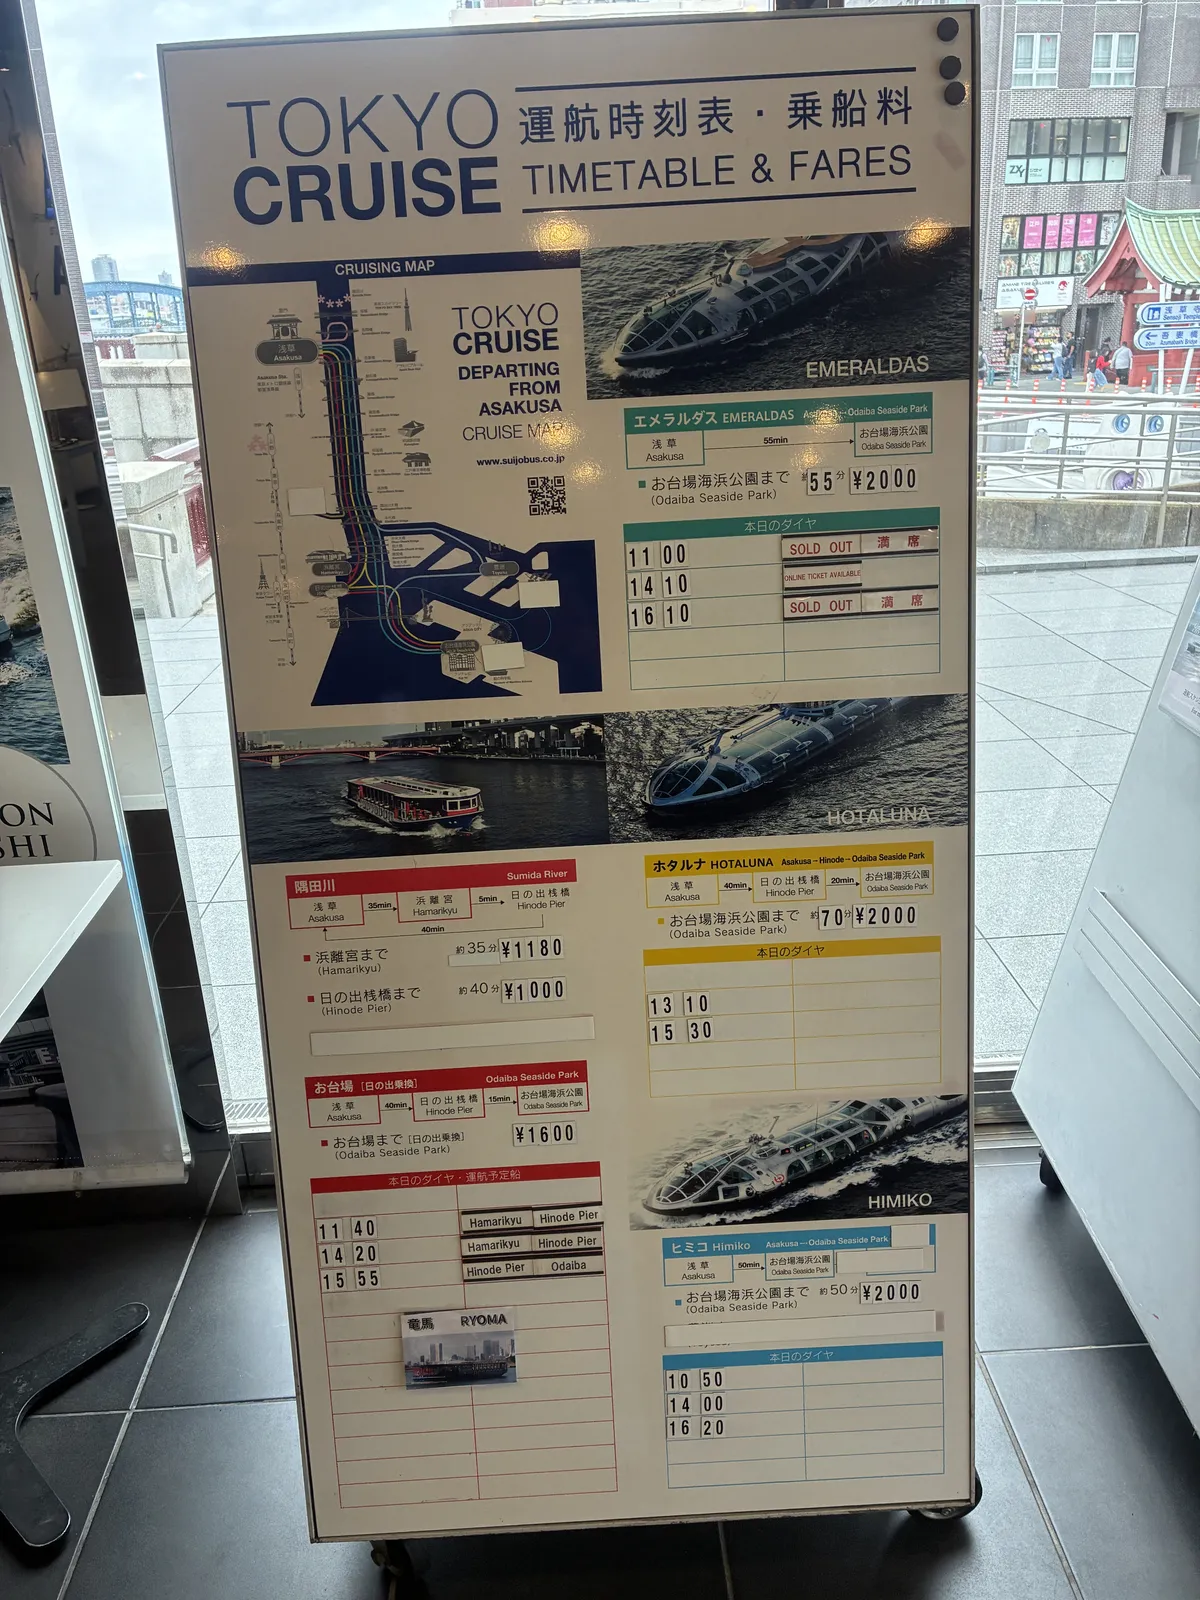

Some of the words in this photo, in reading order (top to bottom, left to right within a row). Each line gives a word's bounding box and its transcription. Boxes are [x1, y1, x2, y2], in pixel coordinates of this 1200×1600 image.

[226, 88, 500, 160] TOKYO
[521, 155, 732, 195] TIMETABLE
[751, 154, 775, 182] &
[790, 146, 912, 181] FARES
[233, 157, 501, 226] CRUISE
[335, 262, 401, 275] CRUISING
[405, 260, 435, 272] MAP
[452, 303, 558, 329] TOKYO
[453, 328, 559, 355] CRUISE
[458, 362, 559, 380] DEPARTING
[807, 355, 929, 379] EMERALDAS
[509, 380, 560, 396] FROM
[479, 399, 562, 416] ASAKUSA
[634, 411, 717, 428] エメラルダス
[723, 410, 794, 424] EMERALDAS
[848, 407, 875, 416] Odaiba
[878, 405, 907, 414] Seaside
[910, 403, 928, 413] Park
[463, 425, 522, 441] CRUISE
[859, 424, 928, 439] お台場海浜公園
[652, 438, 677, 449] 浅草
[764, 436, 788, 445] 55min
[861, 441, 883, 450] Odaiba
[885, 440, 909, 449] Seaside
[910, 440, 927, 448] Park
[477, 455, 565, 466] www.suijobus.co.jp
[646, 452, 684, 462] Asakusa
[652, 470, 791, 491] お台場海浜公園まで
[853, 468, 917, 490] ¥2000
[651, 492, 695, 506] (Odaiba
[699, 491, 743, 503] Seaside
[748, 489, 777, 500] Park)
[744, 518, 817, 533] 本日のダイヤ
[630, 547, 650, 567] 11
[663, 544, 685, 564] 00
[790, 543, 821, 555] SOLD
[830, 541, 853, 553] OUT
[784, 573, 806, 581] ONLINE
[808, 572, 828, 580] TICKET
[829, 570, 861, 578] AVAILABLE
[631, 576, 652, 596] 14
[665, 573, 687, 595] 10
[631, 606, 654, 626] 16
[667, 603, 689, 624] 10
[828, 806, 931, 826] HOTALUNA
[653, 858, 706, 872] ホタルナ
[710, 858, 774, 870] HOTALUNA
[781, 857, 812, 866] Asakusa
[819, 856, 844, 864] Hinode
[852, 854, 877, 862] Odaiba
[879, 852, 907, 861] Seaside
[908, 852, 925, 860] Park
[294, 878, 335, 893] 隅田川
[507, 870, 542, 880] Sumida
[544, 870, 568, 878] River
[670, 881, 694, 891] 浅草
[724, 882, 747, 890] 40min
[831, 876, 854, 884] 20min
[368, 902, 392, 910] 35min
[517, 900, 548, 910] Hinode
[550, 900, 566, 908] Pier
[664, 893, 700, 902] Asakusa
[314, 902, 337, 912] 浅草
[412, 906, 458, 916] Hamarikyu
[856, 906, 916, 924] ¥2000
[308, 913, 344, 923] Asakusa
[670, 910, 800, 927] お台場海浜公園まで
[316, 947, 388, 964] 浜離宮まで
[502, 938, 562, 958] ¥1180
[756, 945, 824, 958] 本日のダイヤ
[318, 963, 382, 976] (Hamarikyu)
[320, 986, 421, 1004] 日の出桟橋まで
[504, 980, 563, 1000] ¥1000
[321, 1005, 364, 1016] (Hinode
[367, 1003, 392, 1014] Pier)
[650, 997, 672, 1014] 13
[686, 995, 708, 1012] 10
[652, 1024, 673, 1042] 15
[690, 1022, 712, 1038] 30
[314, 1081, 354, 1094] お台場
[486, 1074, 518, 1084] Odaiba
[520, 1072, 556, 1082] Seaside
[558, 1070, 579, 1080] Park
[520, 1088, 584, 1100] お台場海浜公園
[334, 1134, 402, 1149] お台場まで
[516, 1124, 574, 1143] ¥1600
[335, 1150, 376, 1160] (Odaiba
[380, 1148, 420, 1158] Seaside
[424, 1145, 450, 1156] Park)
[868, 1193, 932, 1209] HIMIKO
[470, 1215, 522, 1228] Hamarikyu
[540, 1212, 576, 1224] Hinode
[579, 1210, 598, 1221] Pier
[320, 1223, 339, 1240] 11
[354, 1220, 375, 1236] 40
[468, 1238, 520, 1252] Hamarikyu
[538, 1238, 574, 1248] Hinode
[577, 1236, 597, 1246] Pier
[672, 1242, 708, 1253] ヒミコ
[713, 1241, 750, 1252] Himiko
[766, 1240, 799, 1248] Asakusa
[808, 1238, 836, 1246] Odaiba
[838, 1236, 869, 1245] Seaside
[871, 1234, 889, 1243] Park
[322, 1248, 343, 1264] 14
[356, 1245, 376, 1262] 20
[467, 1264, 502, 1277] Hinode
[505, 1262, 525, 1274] Pier
[551, 1260, 586, 1272] Odaiba
[738, 1261, 760, 1269] 50min
[324, 1272, 344, 1290] 15
[358, 1270, 378, 1287] 55
[687, 1286, 809, 1304] お台場海浜公園まで
[863, 1284, 920, 1301] ¥2000
[408, 1318, 434, 1332] 竜馬
[460, 1314, 508, 1327] RYOMA
[770, 1350, 833, 1362] 本日のダイヤ
[669, 1373, 688, 1390] 10
[703, 1371, 722, 1387] 50
[670, 1397, 689, 1413] 14
[704, 1395, 723, 1412] 00
[670, 1420, 689, 1436] 16
[703, 1419, 724, 1435] 20
